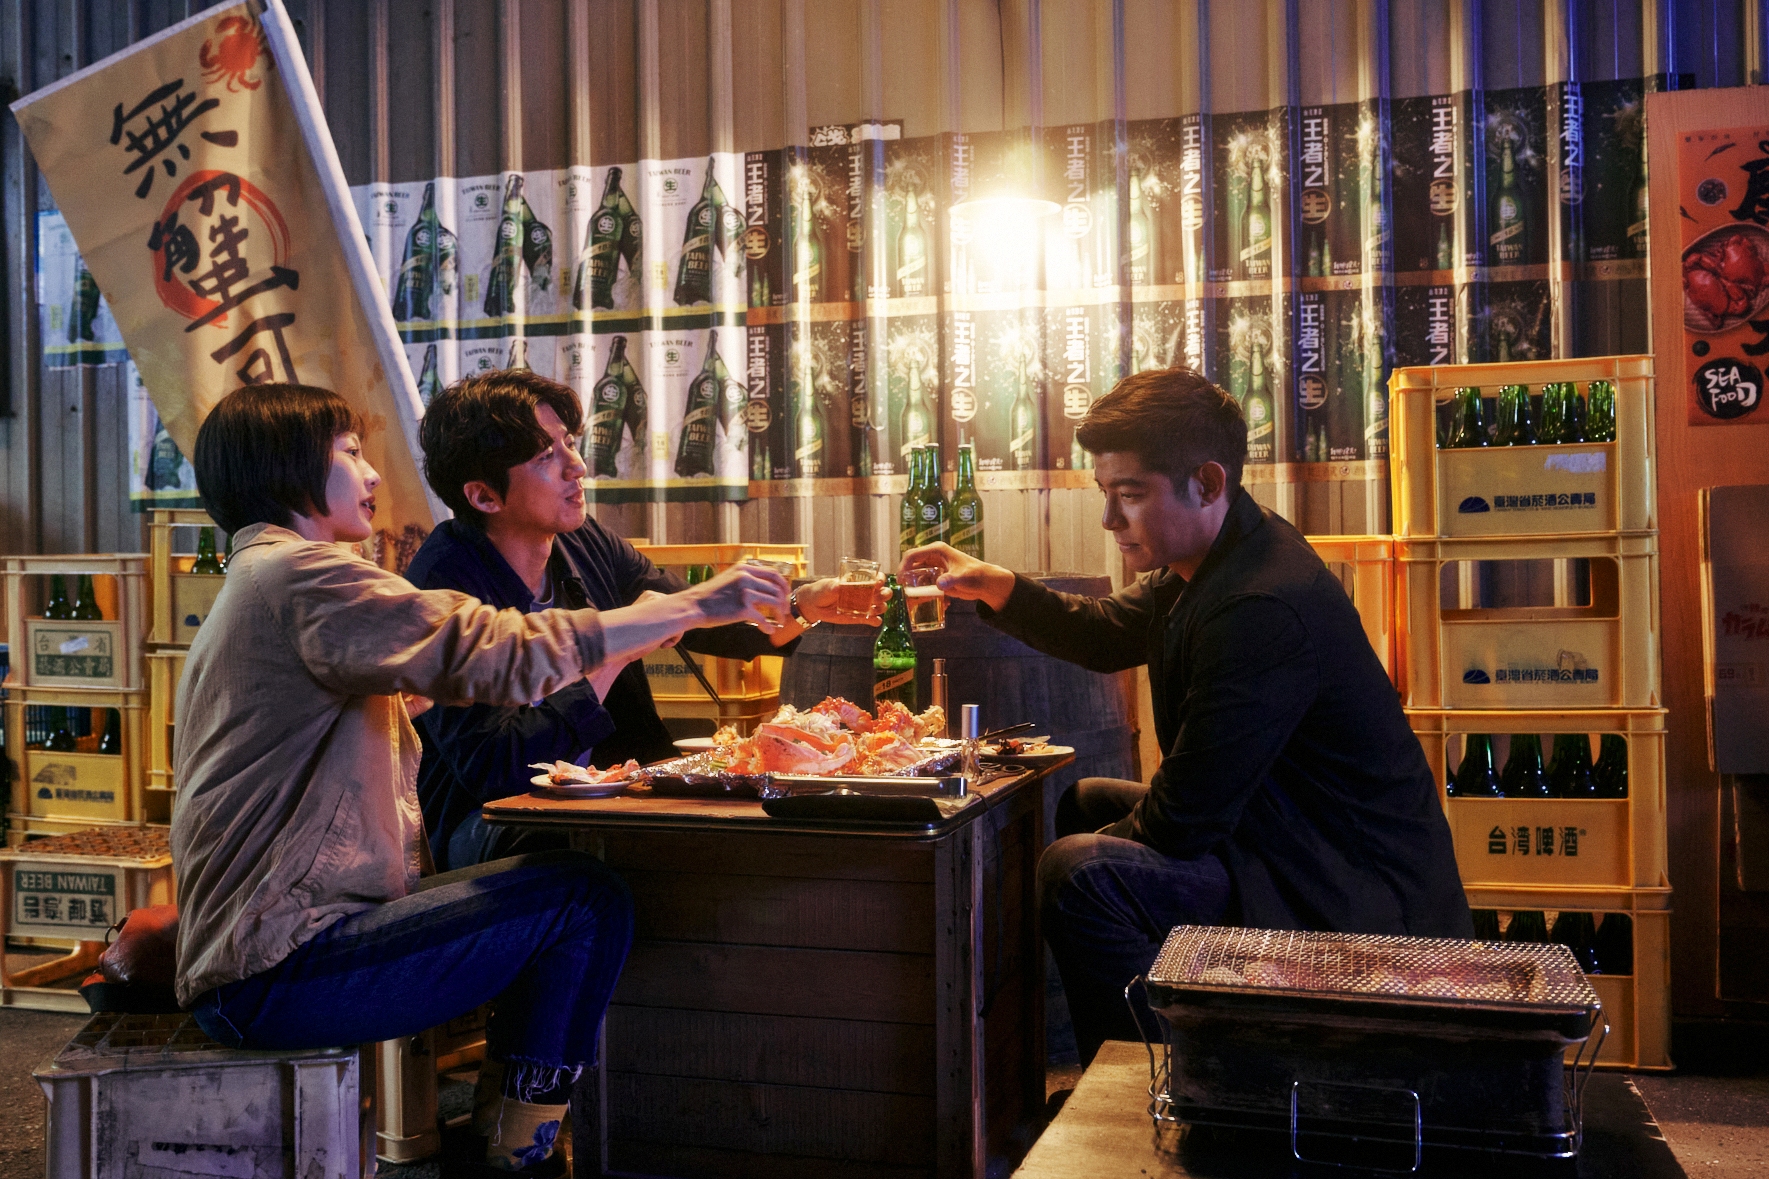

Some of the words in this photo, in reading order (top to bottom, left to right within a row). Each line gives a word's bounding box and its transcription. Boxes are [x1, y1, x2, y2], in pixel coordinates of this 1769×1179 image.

[1704, 366, 1741, 389] SEA
[1709, 382, 1757, 412] FOOD
[20, 873, 52, 889] BEER
[57, 875, 107, 892] TAIWAN
